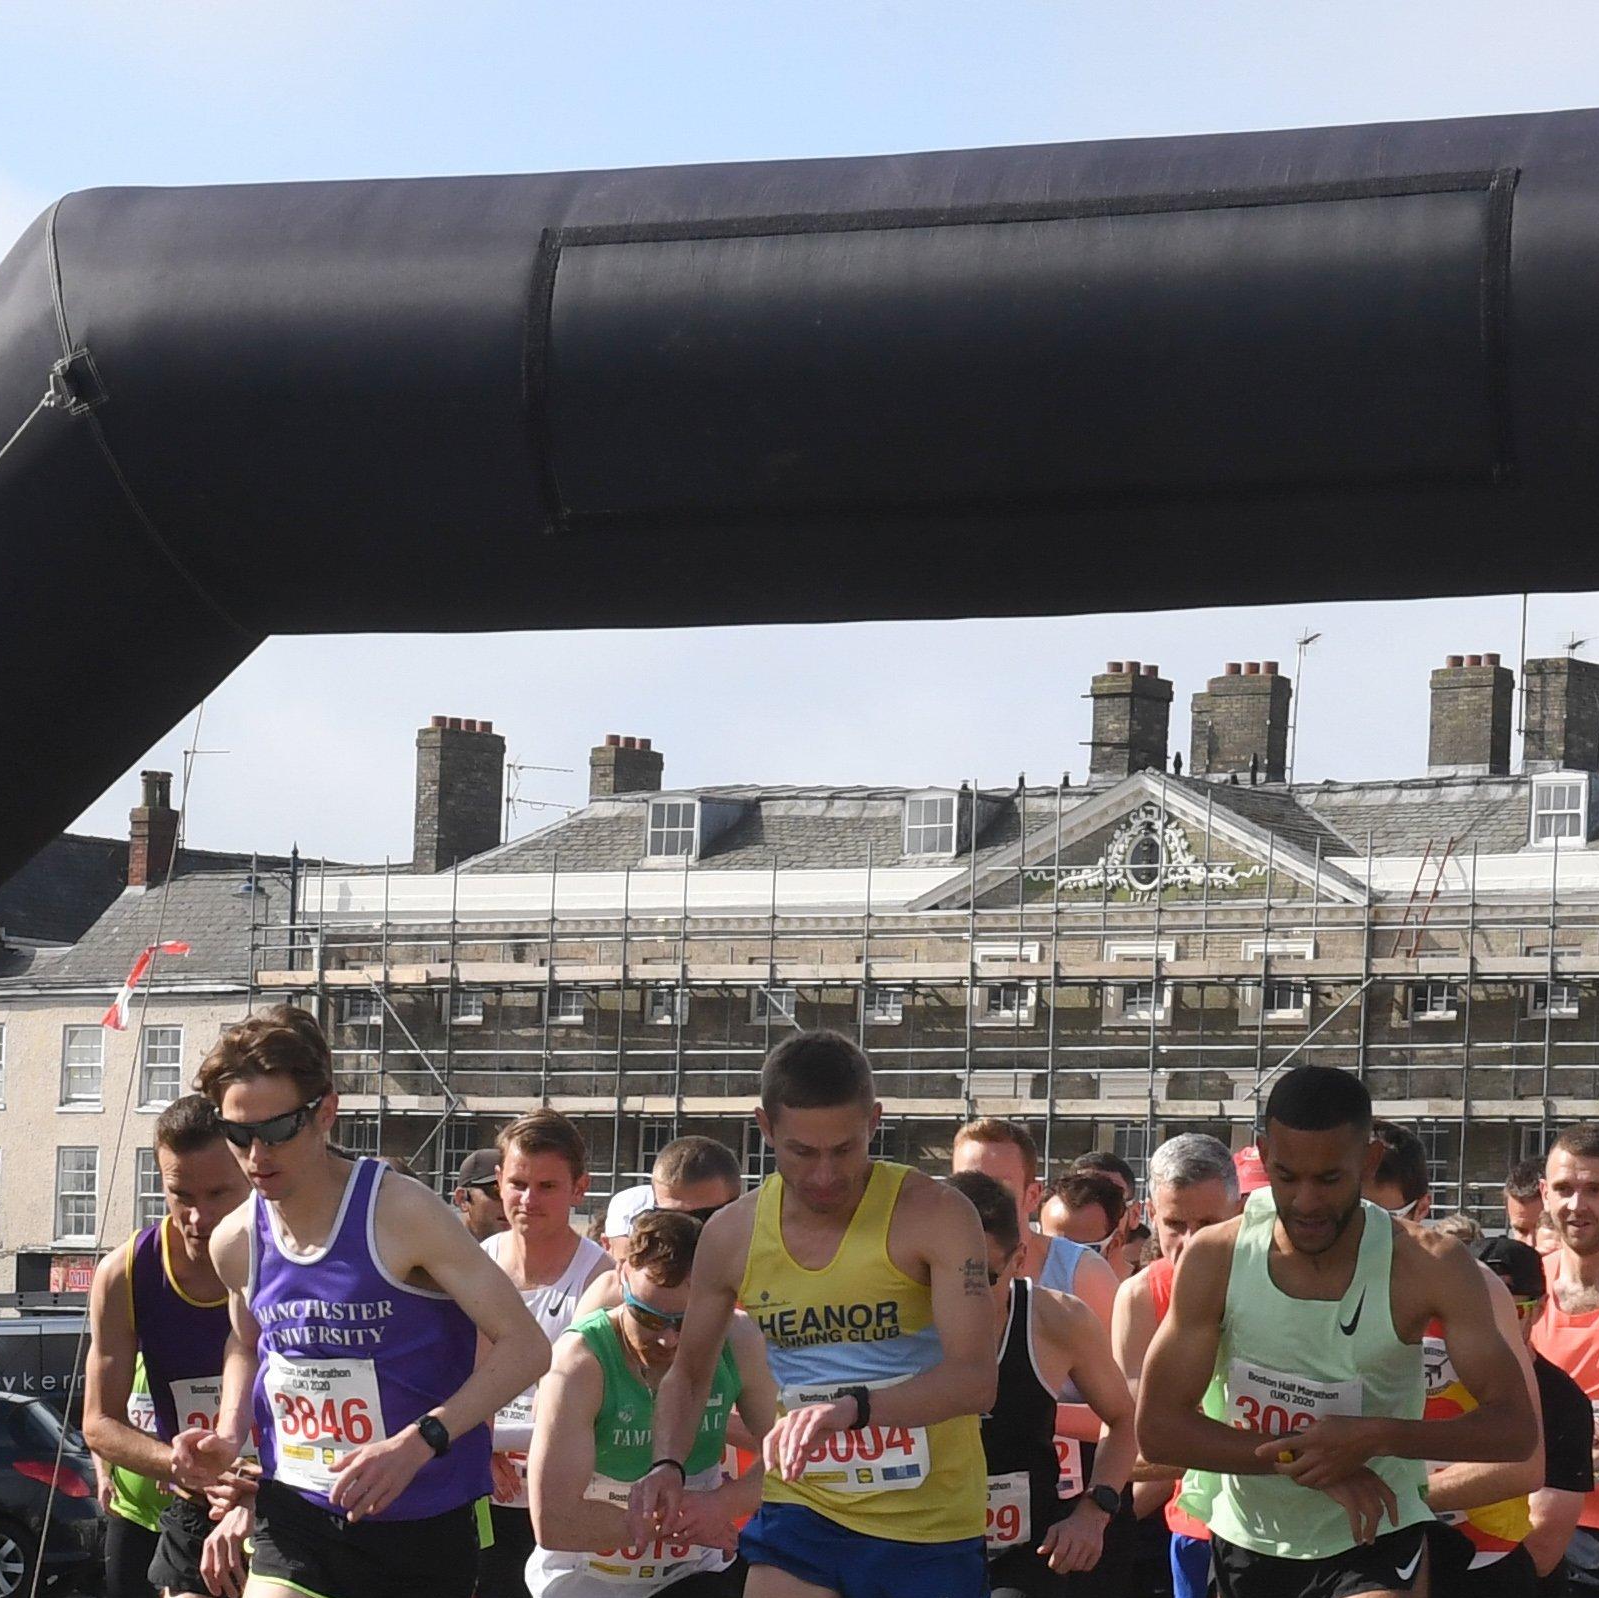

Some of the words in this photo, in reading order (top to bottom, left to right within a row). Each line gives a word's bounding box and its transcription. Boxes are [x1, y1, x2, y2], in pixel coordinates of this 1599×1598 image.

[256, 1298, 394, 1325] MANCHESTER
[758, 1300, 899, 1338] HEANOR
[779, 1330, 843, 1349] NNING
[848, 1325, 901, 1343] CLUB
[311, 1368, 352, 1379] Marathon
[189, 1385, 219, 1394] Boston
[292, 1379, 309, 1390] (UK)
[310, 1380, 331, 1391] 2020
[1248, 1371, 1277, 1388] Boston
[1277, 1380, 1297, 1393] Half
[1297, 1385, 1340, 1400] Marathon
[799, 1392, 829, 1403] Boston
[1270, 1389, 1291, 1403] (UK)
[1291, 1394, 1317, 1408] 2020
[274, 1391, 373, 1445] 3846
[509, 1410, 526, 1421] 2020
[1233, 1395, 1318, 1435] 30
[608, 1491, 628, 1502] Bost
